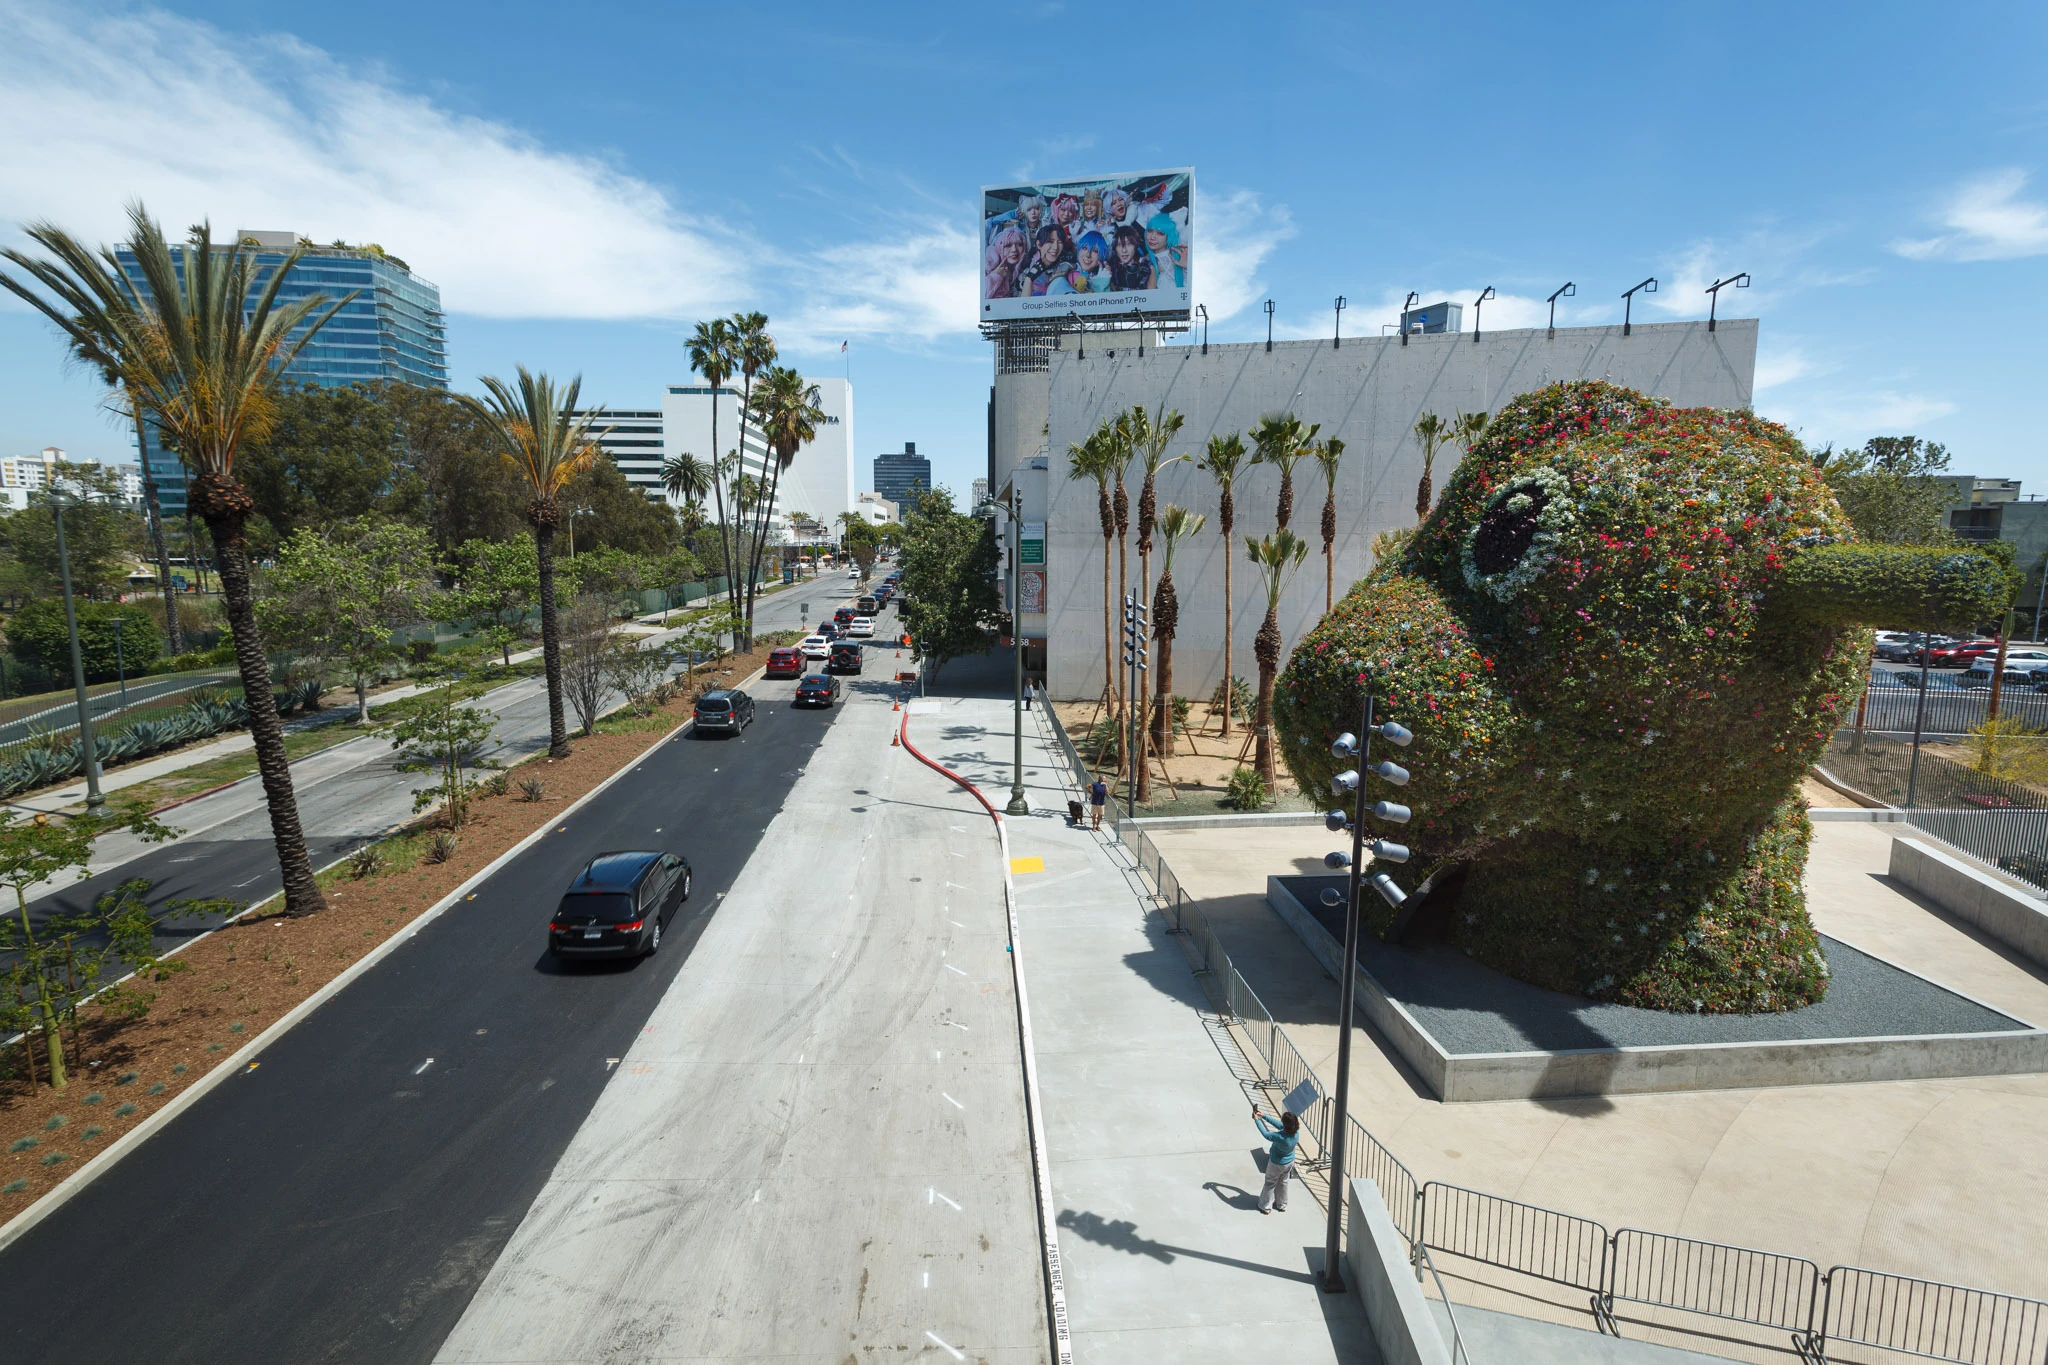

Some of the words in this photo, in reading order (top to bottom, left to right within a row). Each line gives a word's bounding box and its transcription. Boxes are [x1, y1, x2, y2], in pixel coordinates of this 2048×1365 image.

[1022, 302, 1044, 310] Group
[1044, 300, 1068, 308] Selfies
[1069, 299, 1087, 307] Shot
[1098, 297, 1124, 306] iPhone
[1124, 296, 1133, 304] 17
[1133, 296, 1147, 304] Pro
[1010, 637, 1030, 647] 558
[1048, 1244, 1063, 1291] PASSENGER
[1055, 1301, 1069, 1341] LOADING
